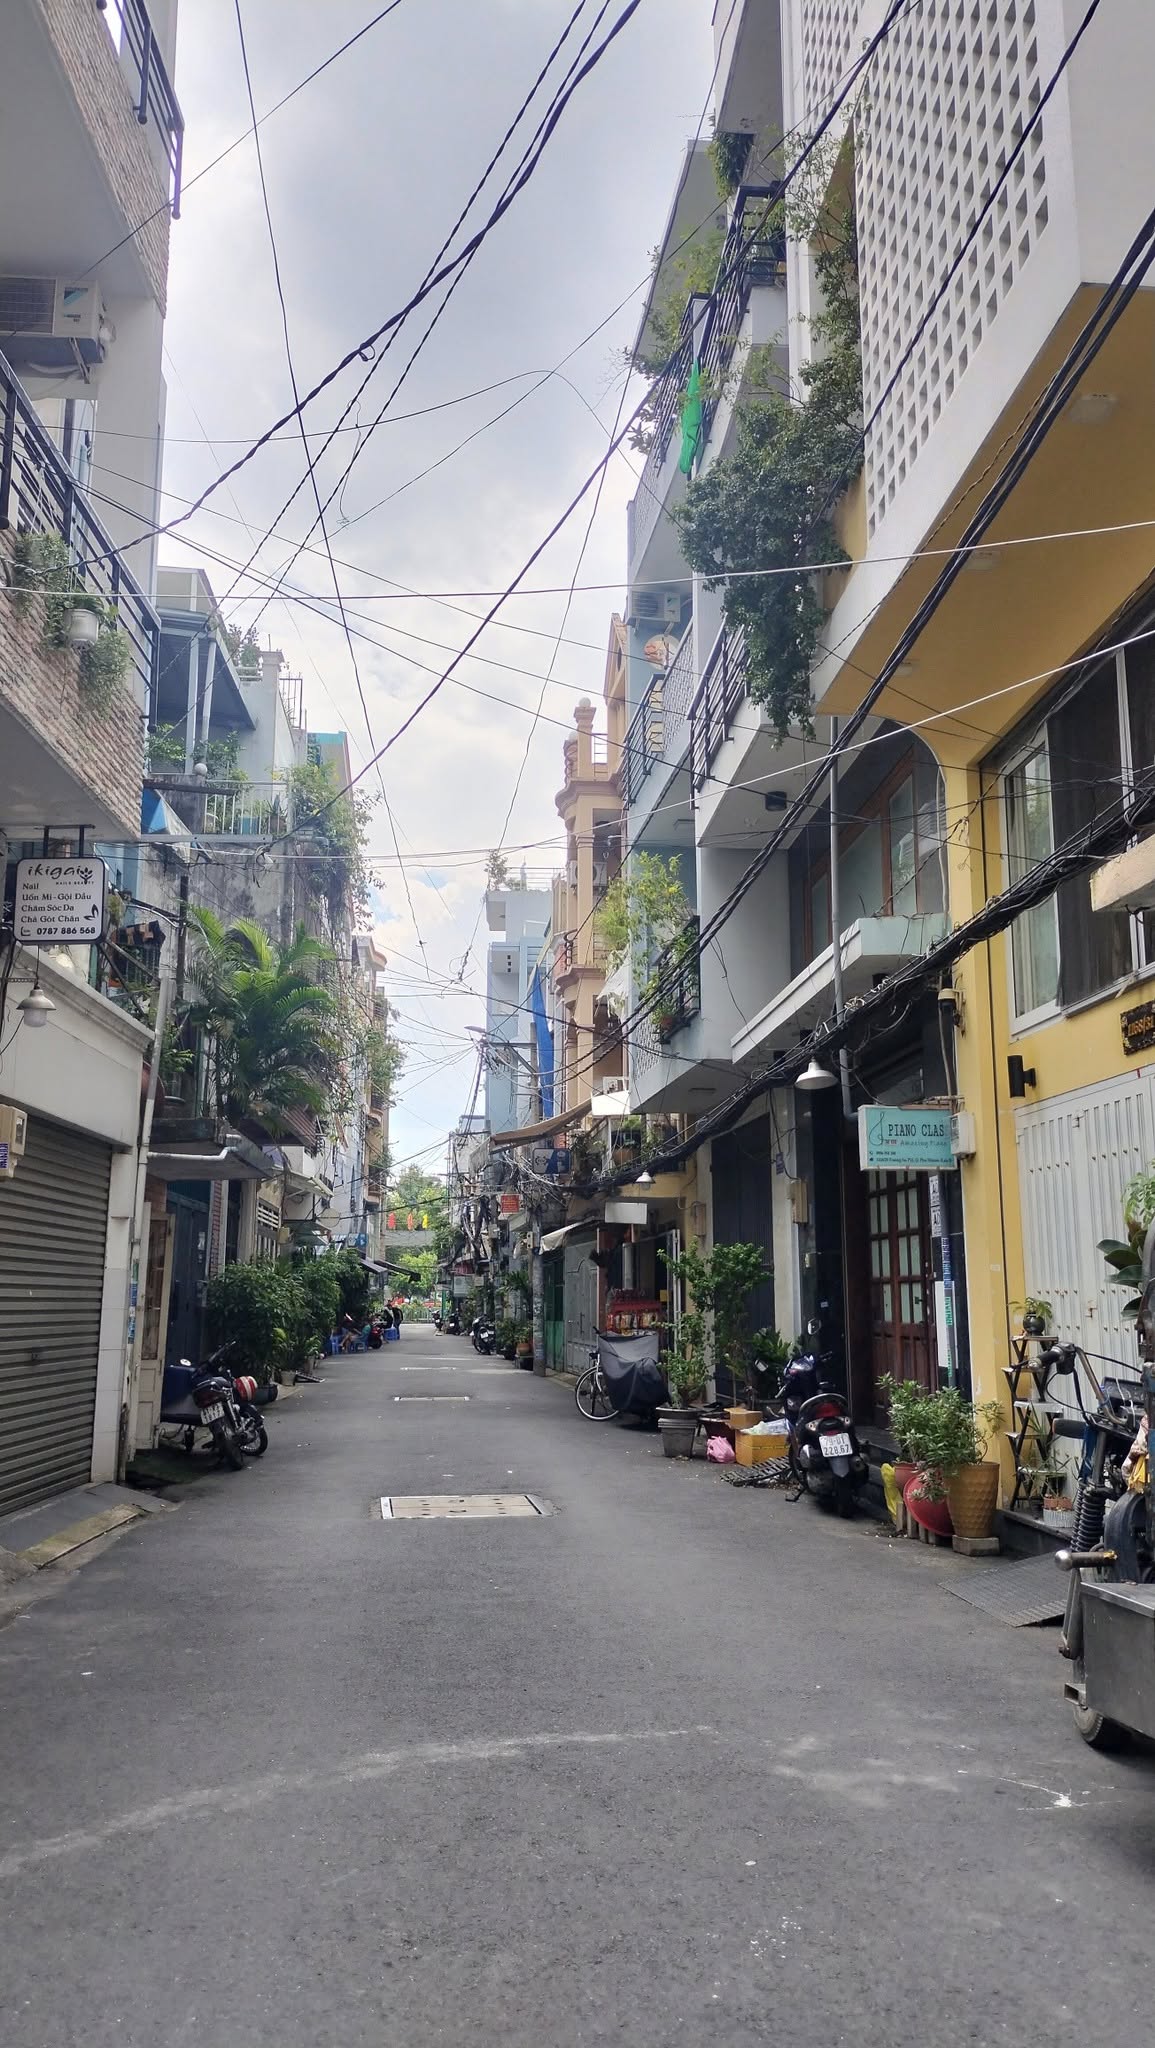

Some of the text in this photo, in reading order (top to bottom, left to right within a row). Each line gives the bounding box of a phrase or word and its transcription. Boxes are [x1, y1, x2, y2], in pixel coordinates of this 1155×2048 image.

[28, 863, 80, 879] ikigai
[63, 903, 75, 912] Da
[36, 926, 96, 935] 0787 886 568
[888, 1124, 917, 1137] PIANO
